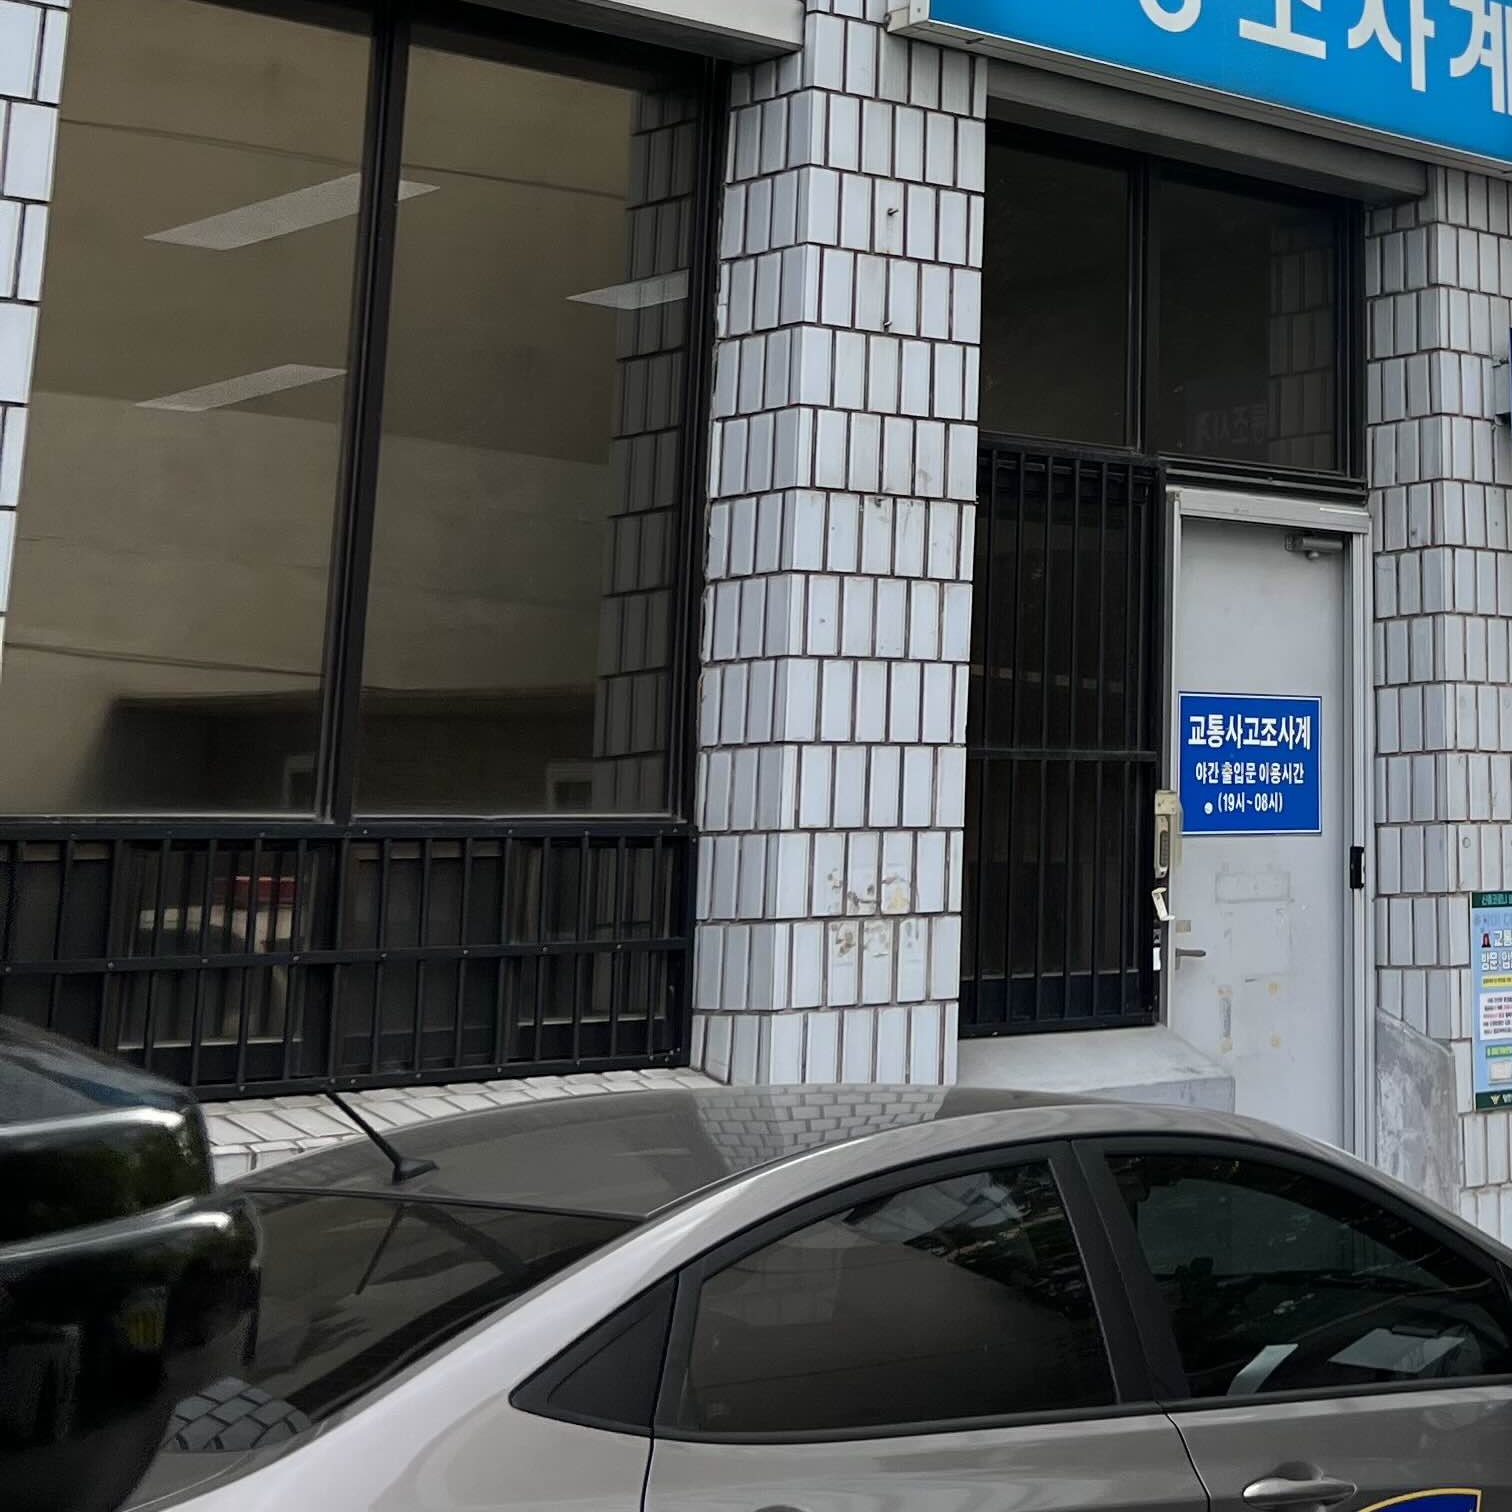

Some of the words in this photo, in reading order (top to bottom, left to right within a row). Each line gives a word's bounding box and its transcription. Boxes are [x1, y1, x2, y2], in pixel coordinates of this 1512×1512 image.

[1188, 713, 1311, 751] 교통사고조사계
[1195, 761, 1219, 785] 야간
[1221, 760, 1257, 785] 출입문
[1258, 761, 1305, 785] 이용시간
